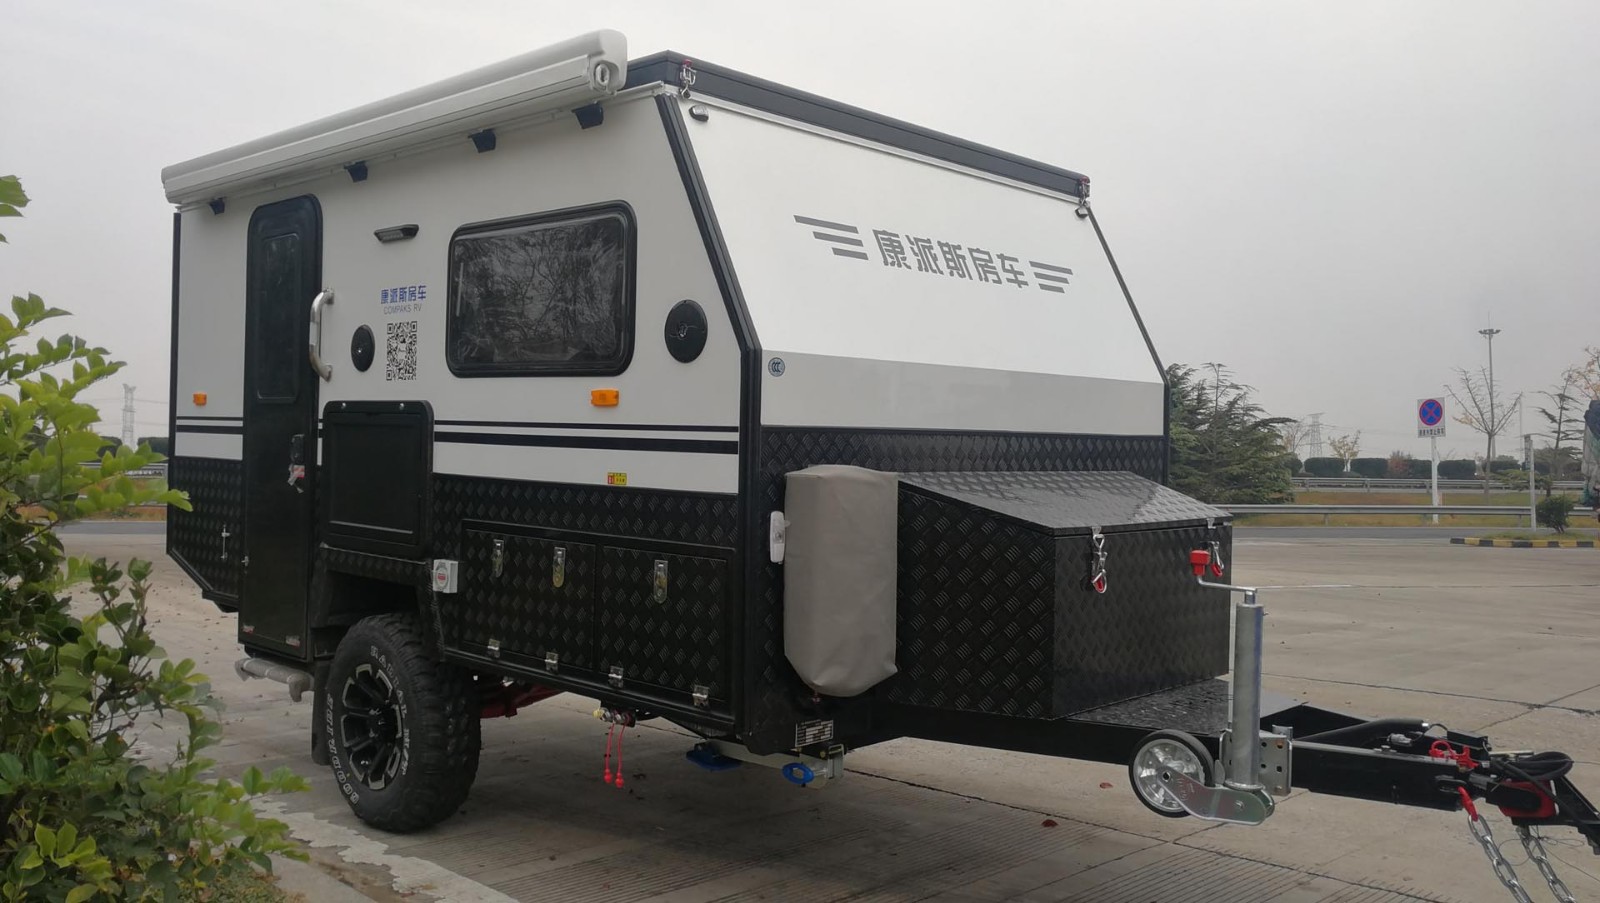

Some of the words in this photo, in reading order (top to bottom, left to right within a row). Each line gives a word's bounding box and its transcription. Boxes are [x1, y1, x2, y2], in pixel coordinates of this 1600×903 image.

[872, 229, 1029, 288] 康派斯房车
[381, 285, 426, 304] 康派斯房车
[384, 305, 412, 315] COMPAKS
[413, 303, 422, 312] RV
